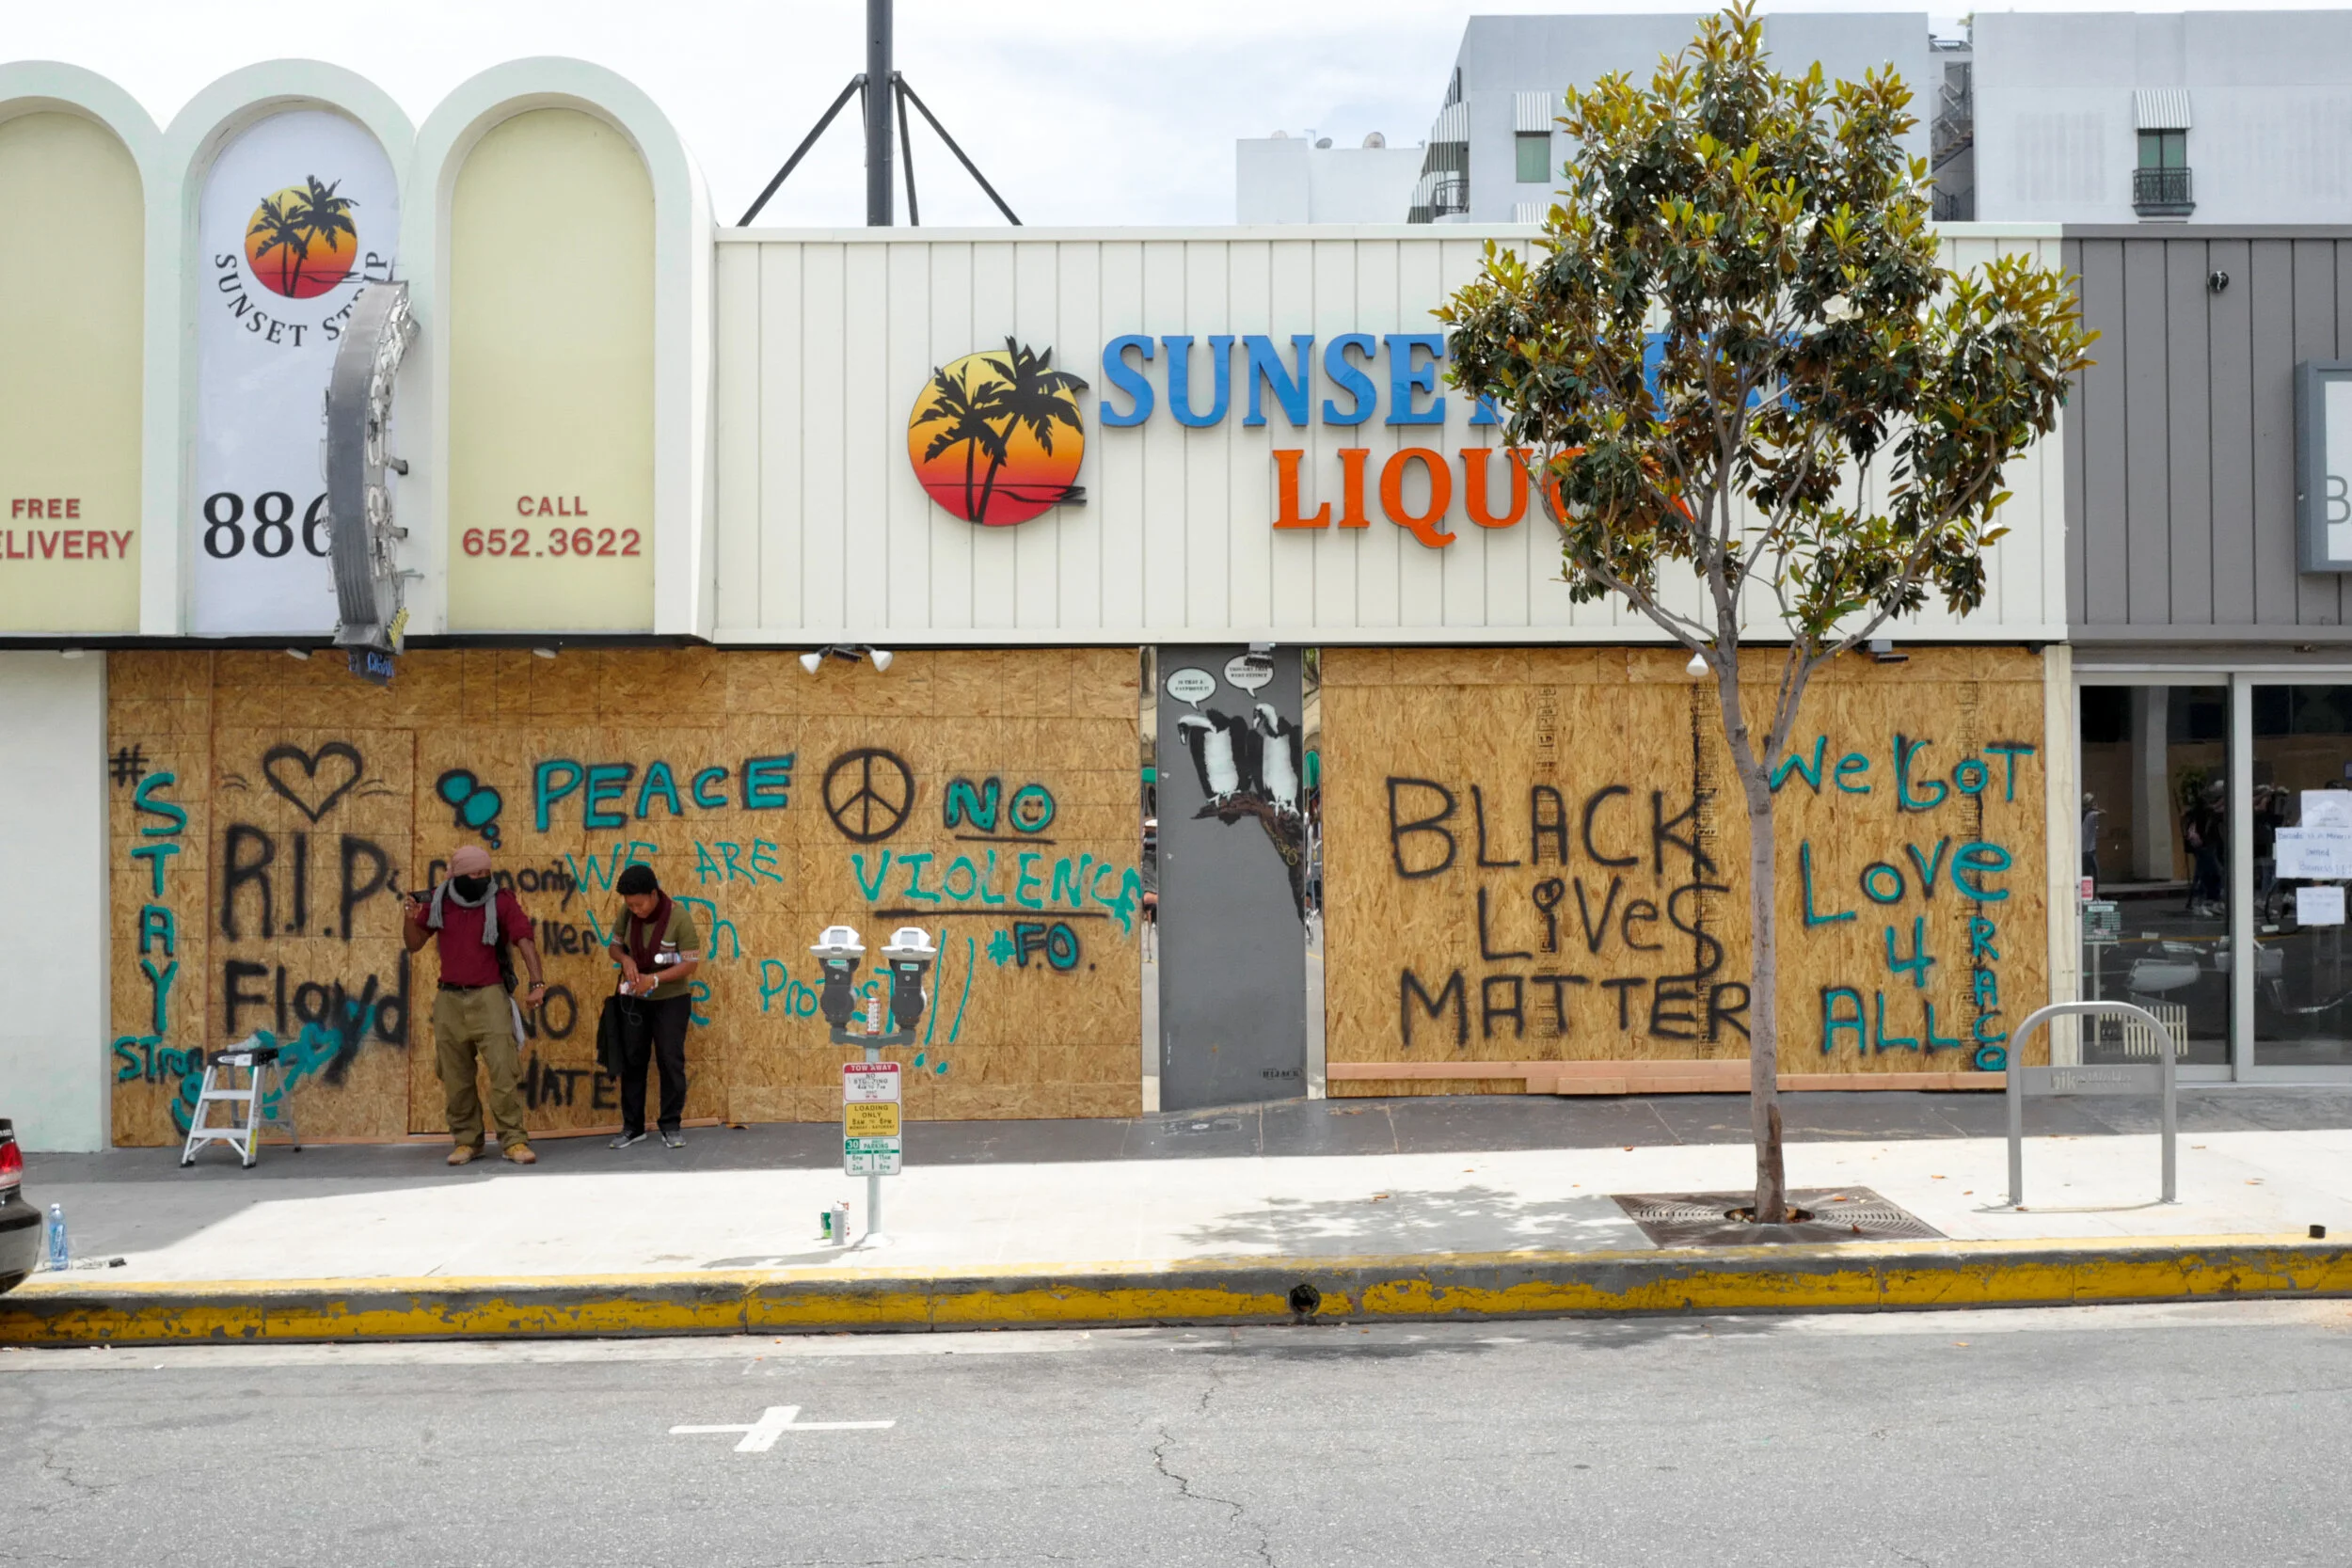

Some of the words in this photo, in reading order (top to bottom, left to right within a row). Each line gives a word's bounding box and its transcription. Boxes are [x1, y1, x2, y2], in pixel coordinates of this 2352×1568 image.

[215, 253, 308, 347] SUNSET
[322, 251, 388, 341] STIP
[1100, 334, 1505, 428] SUNSE
[11, 498, 81, 519] FREE
[516, 495, 589, 518] CALL
[1271, 446, 1694, 548] LIQU
[0, 529, 135, 560] LIVERY
[461, 528, 642, 558] 652.3622
[943, 776, 1057, 833] NO
[1387, 776, 1718, 889] BLACK
[692, 838, 783, 885] ARE
[1884, 915, 1936, 988] 4
[224, 948, 410, 1085] Floyd
[1401, 969, 1751, 1049] MATTER
[1820, 986, 1962, 1057] ALL
[847, 1139, 860, 1148] 30
